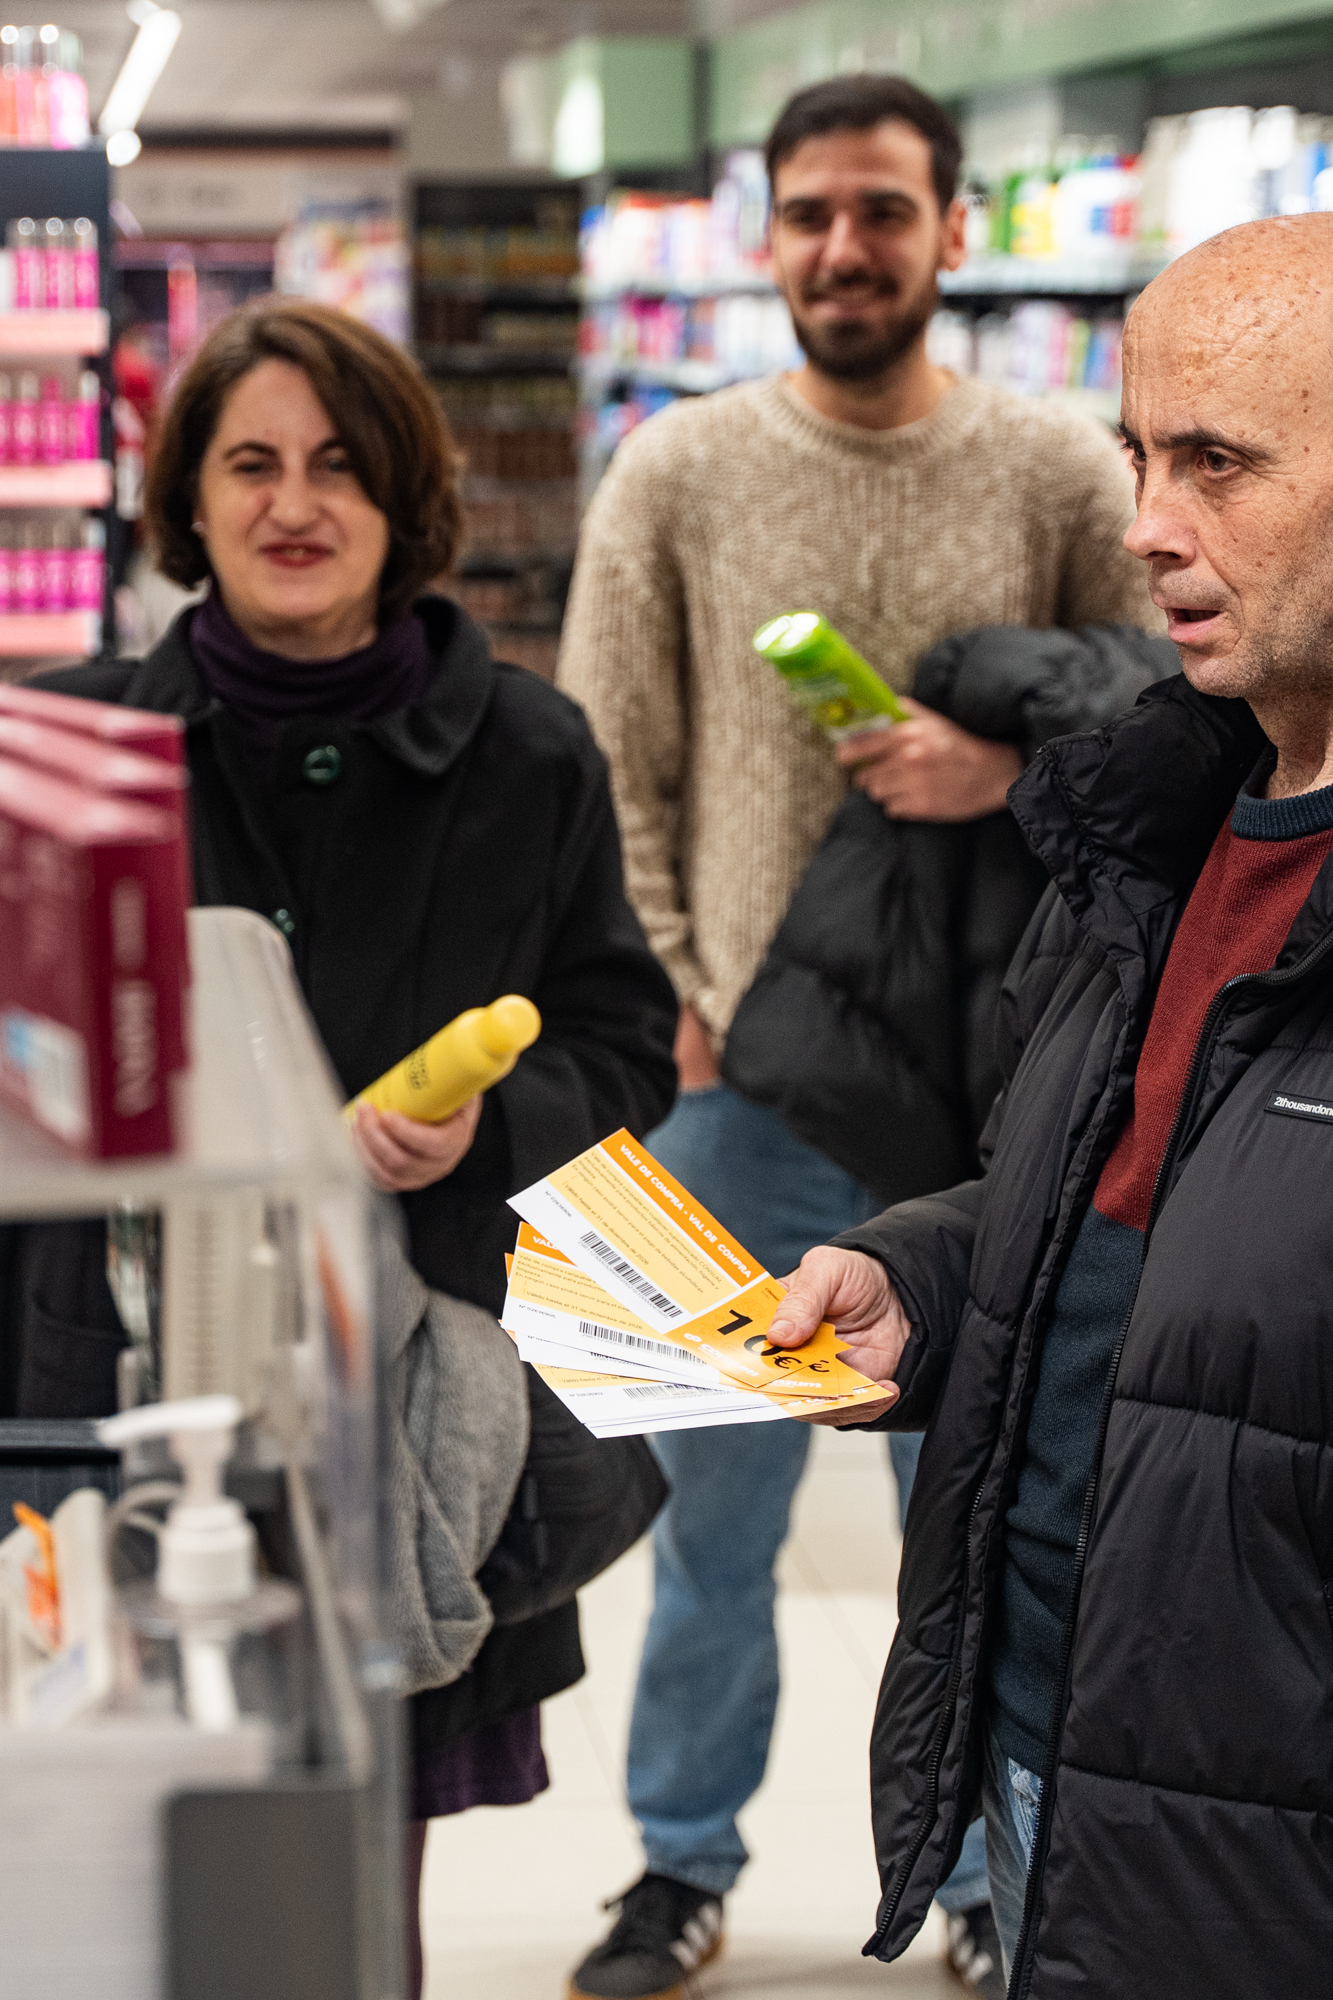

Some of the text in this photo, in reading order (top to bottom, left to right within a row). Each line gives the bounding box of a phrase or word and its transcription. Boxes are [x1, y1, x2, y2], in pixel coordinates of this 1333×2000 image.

[1274, 1096, 1333, 1116] 2thousandon
[590, 1151, 601, 1162] Vale
[605, 1168, 623, 1186] compra
[647, 1211, 669, 1231] cualquier
[667, 1231, 700, 1261] supermercado
[618, 1144, 642, 1166] VALE
[637, 1164, 653, 1177] DE
[649, 1176, 685, 1210] COMPRA
[687, 1213, 705, 1231] VAL
[702, 1229, 718, 1243] DE
[716, 1243, 752, 1278] COMPRA
[577, 1197, 592, 1210] hasta
[607, 1226, 631, 1248] diciembre
[635, 1253, 649, 1265] 2026
[582, 1156, 617, 1189] exclusivamente
[614, 1189, 627, 1200] para
[624, 1199, 649, 1221] productos
[697, 1270, 716, 1286] higiene
[592, 1186, 604, 1196] caso
[616, 1209, 629, 1221] servir
[627, 1221, 640, 1232] para
[642, 1236, 656, 1248] pago
[660, 1253, 680, 1270] bebidas
[532, 1236, 558, 1250] VAL
[517, 1260, 562, 1278] exclusivamente
[518, 1253, 531, 1261] Vale
[542, 1262, 563, 1273] compra
[545, 1296, 562, 1305] hasta
[588, 1310, 617, 1322] diciembre
[770, 1380, 822, 1388] nsum
